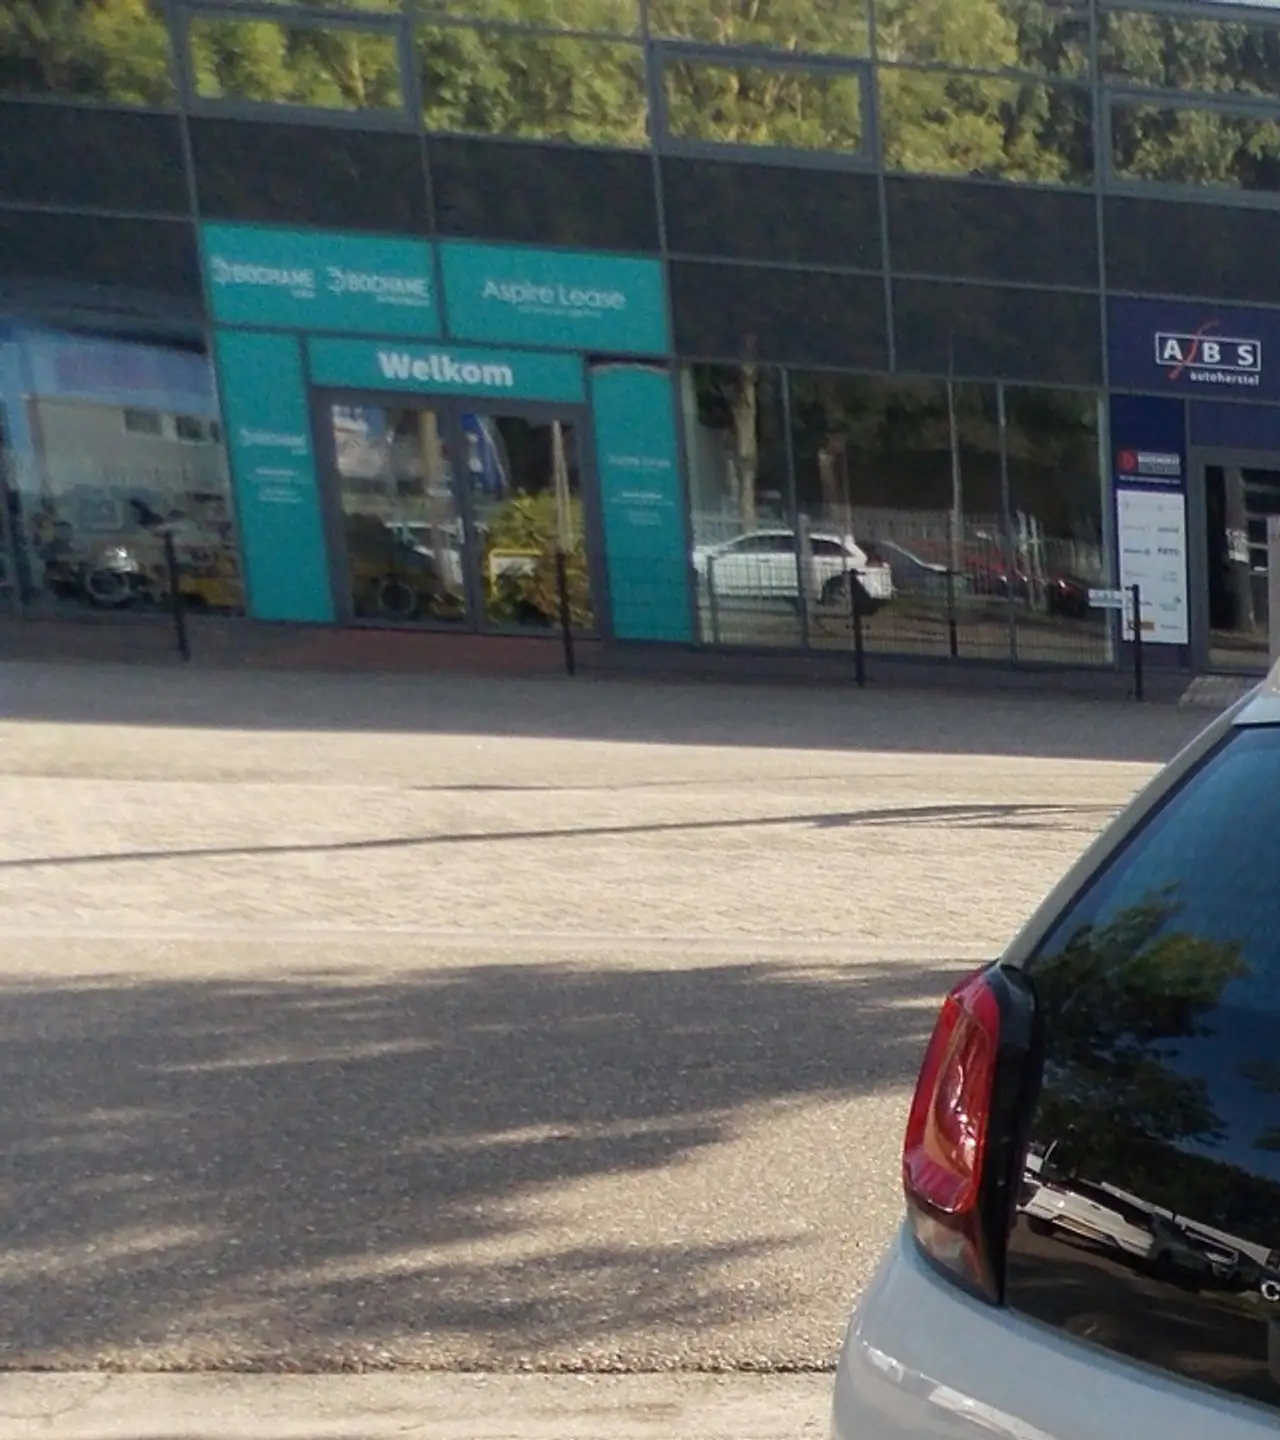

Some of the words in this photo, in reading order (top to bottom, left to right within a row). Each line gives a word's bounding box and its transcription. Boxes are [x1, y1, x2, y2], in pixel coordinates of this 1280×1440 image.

[481, 280, 555, 306] Aspire
[558, 284, 627, 310] Lease
[377, 351, 515, 388] Welkom
